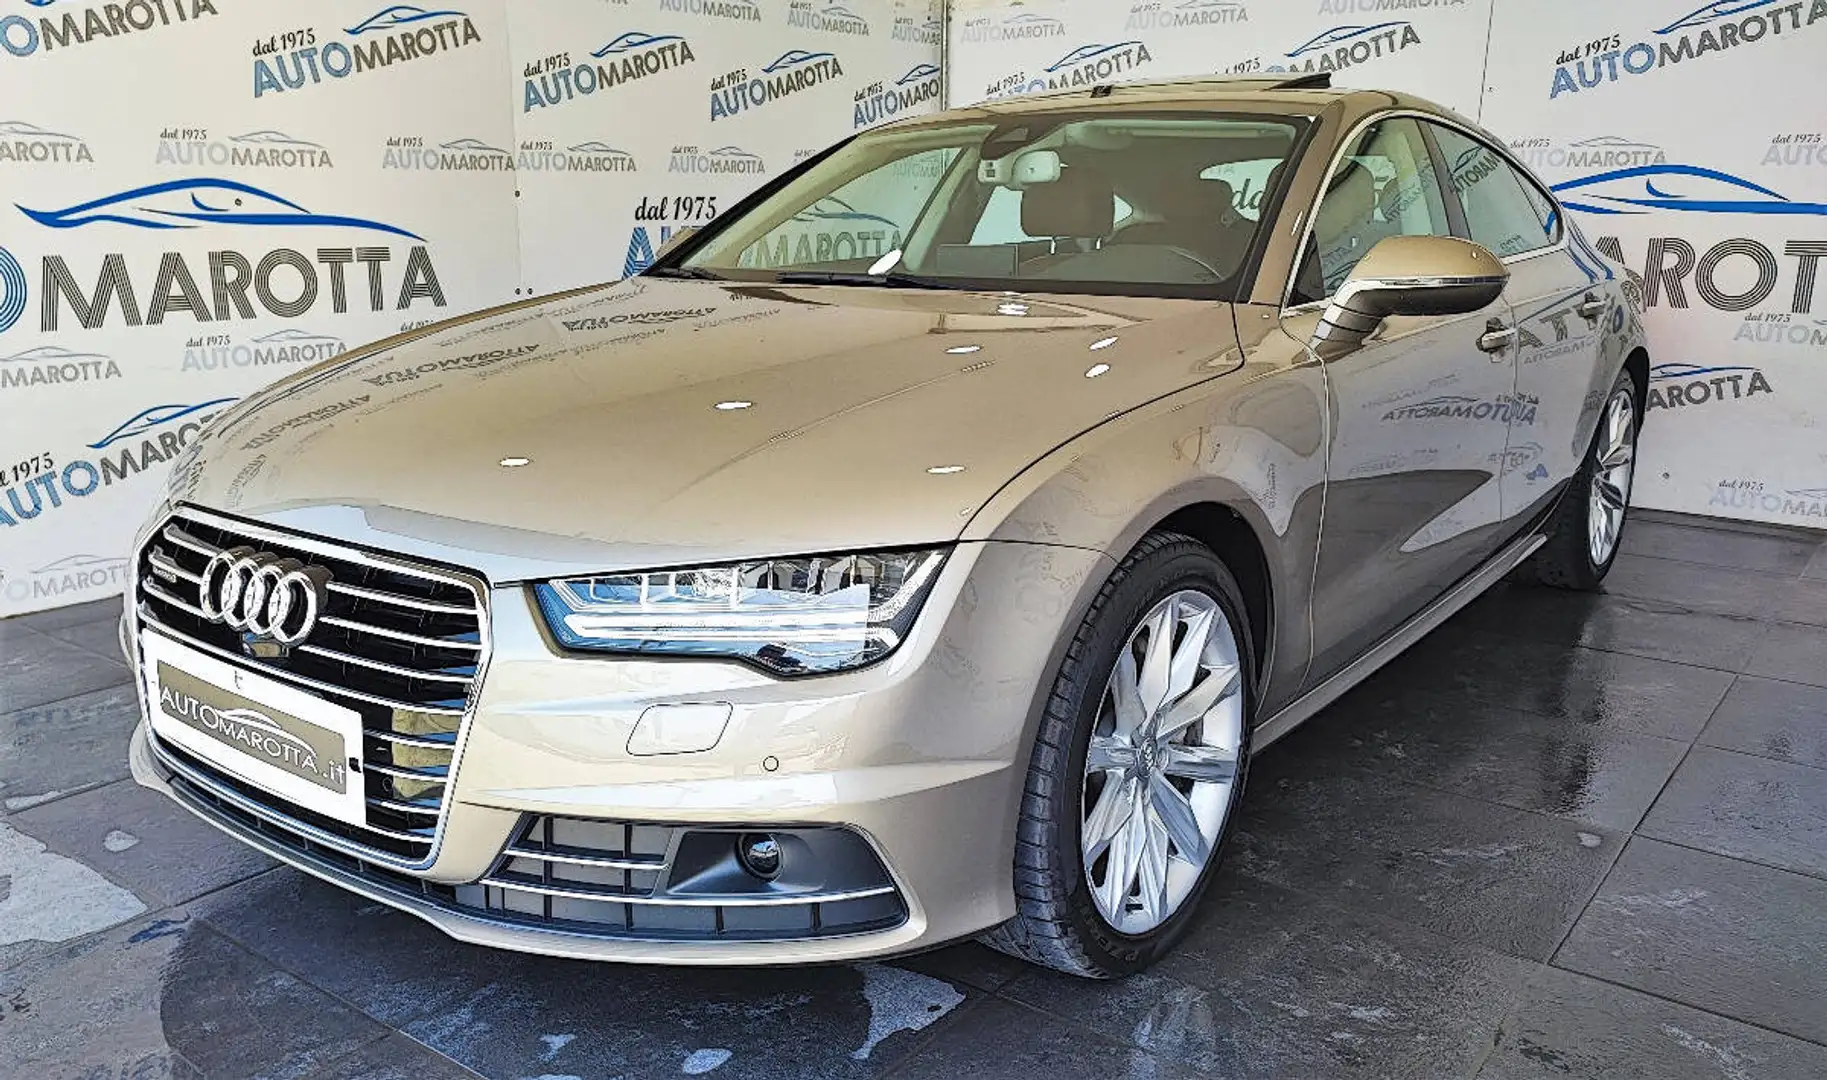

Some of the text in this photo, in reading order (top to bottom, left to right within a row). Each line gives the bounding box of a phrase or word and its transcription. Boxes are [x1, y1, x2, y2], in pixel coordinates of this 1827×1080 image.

[1124, 8, 1249, 31] AUTOMAROTTA
[252, 28, 316, 56] dal 1975
[1549, 0, 1827, 99] AUTOMAROTTA
[1556, 34, 1621, 65] dal 1975
[254, 17, 481, 98] AUTOMAROTTA
[524, 52, 571, 77] dal 1975
[524, 41, 696, 113] AUTOMAROTTA
[711, 69, 748, 91] dal 1975
[711, 58, 843, 121] AUTOMAROTTA
[854, 76, 941, 128] AUTOMARO
[160, 129, 207, 140] dal 1975
[1772, 134, 1791, 144] dal
[155, 141, 333, 168] AUTOMAROTTA
[382, 149, 515, 171] AUTOMAROTTA
[516, 152, 637, 172] AUTOMAROTTA
[668, 155, 765, 174] AUTOMAROTTA
[634, 196, 717, 220] dal 1975
[1744, 313, 1791, 322] dal 1975
[186, 335, 231, 348] dal 1975
[181, 342, 347, 371] AUTOMAROTTA
[1, 360, 122, 388] MAROTTA
[12, 452, 54, 482] 1975
[161, 686, 318, 773] AUTOMAROTTA
